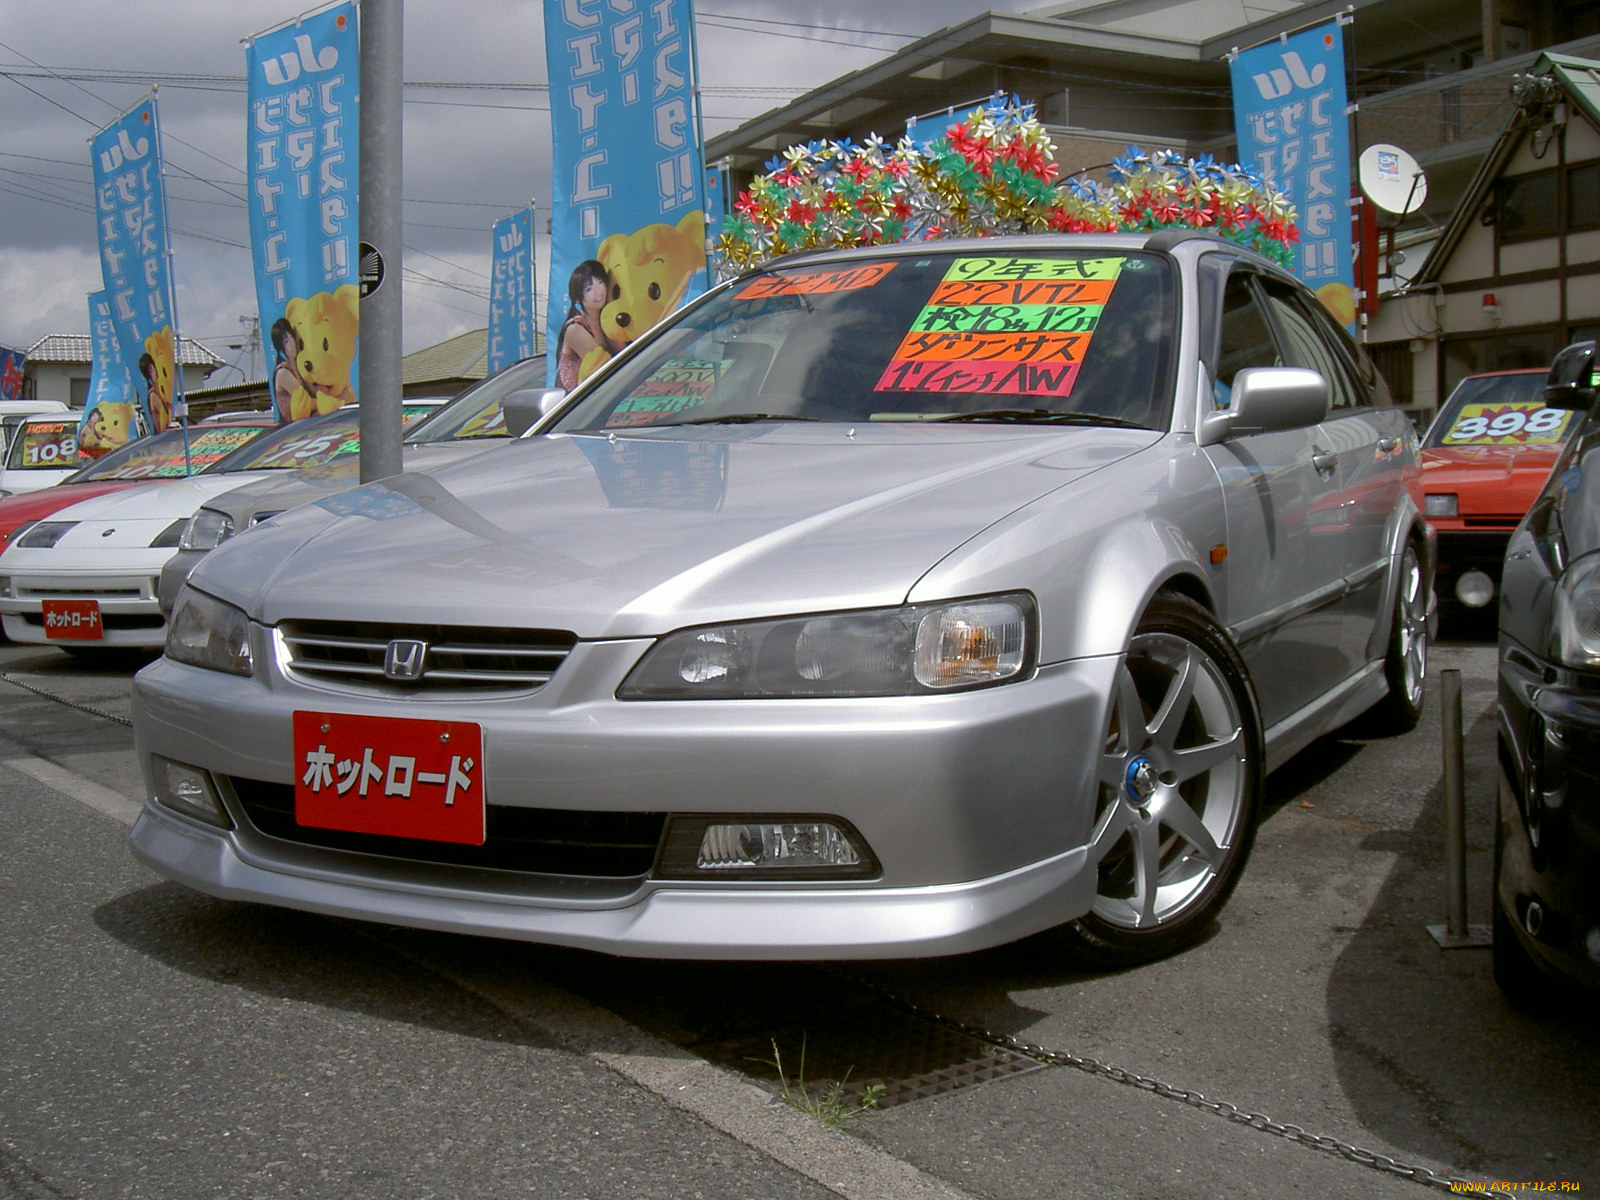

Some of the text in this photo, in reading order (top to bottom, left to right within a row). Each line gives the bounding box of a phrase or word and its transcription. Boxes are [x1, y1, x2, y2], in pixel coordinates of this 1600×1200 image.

[957, 258, 1104, 280] 9年式
[1451, 408, 1566, 439] 398
[30, 438, 77, 463] 108
[46, 610, 98, 628] ホットロード
[302, 744, 474, 806] ホットロード
